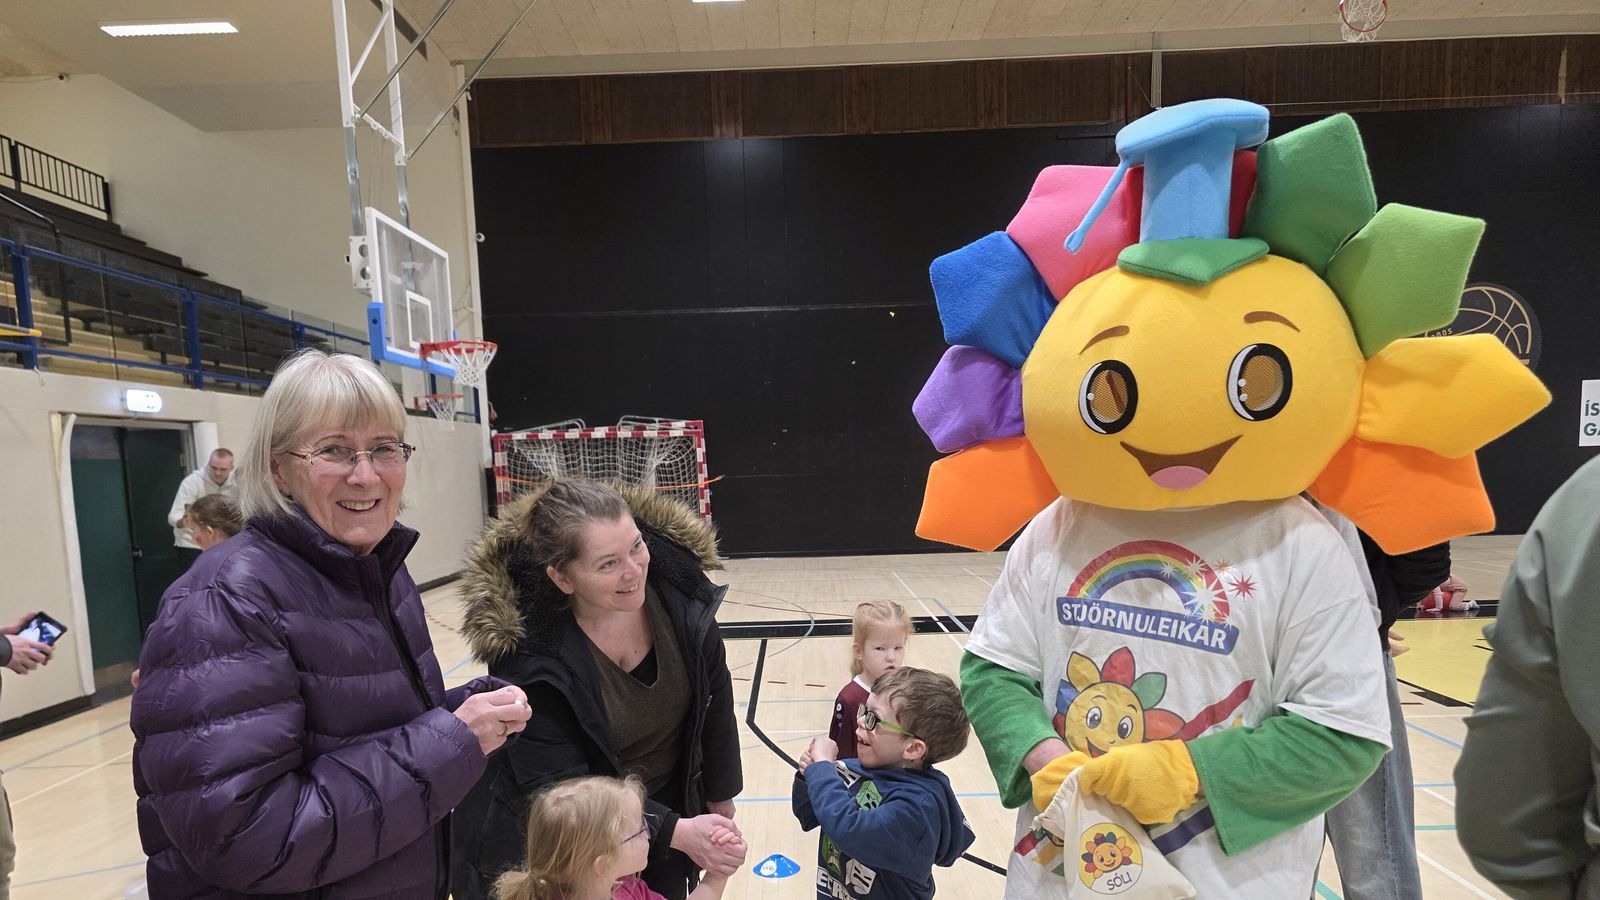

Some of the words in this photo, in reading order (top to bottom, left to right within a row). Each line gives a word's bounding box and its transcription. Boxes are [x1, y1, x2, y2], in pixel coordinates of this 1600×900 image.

[1583, 422, 1600, 436] G
[1062, 602, 1227, 650] STJÖRNULEIKAR
[1106, 872, 1133, 891] SÓLI
